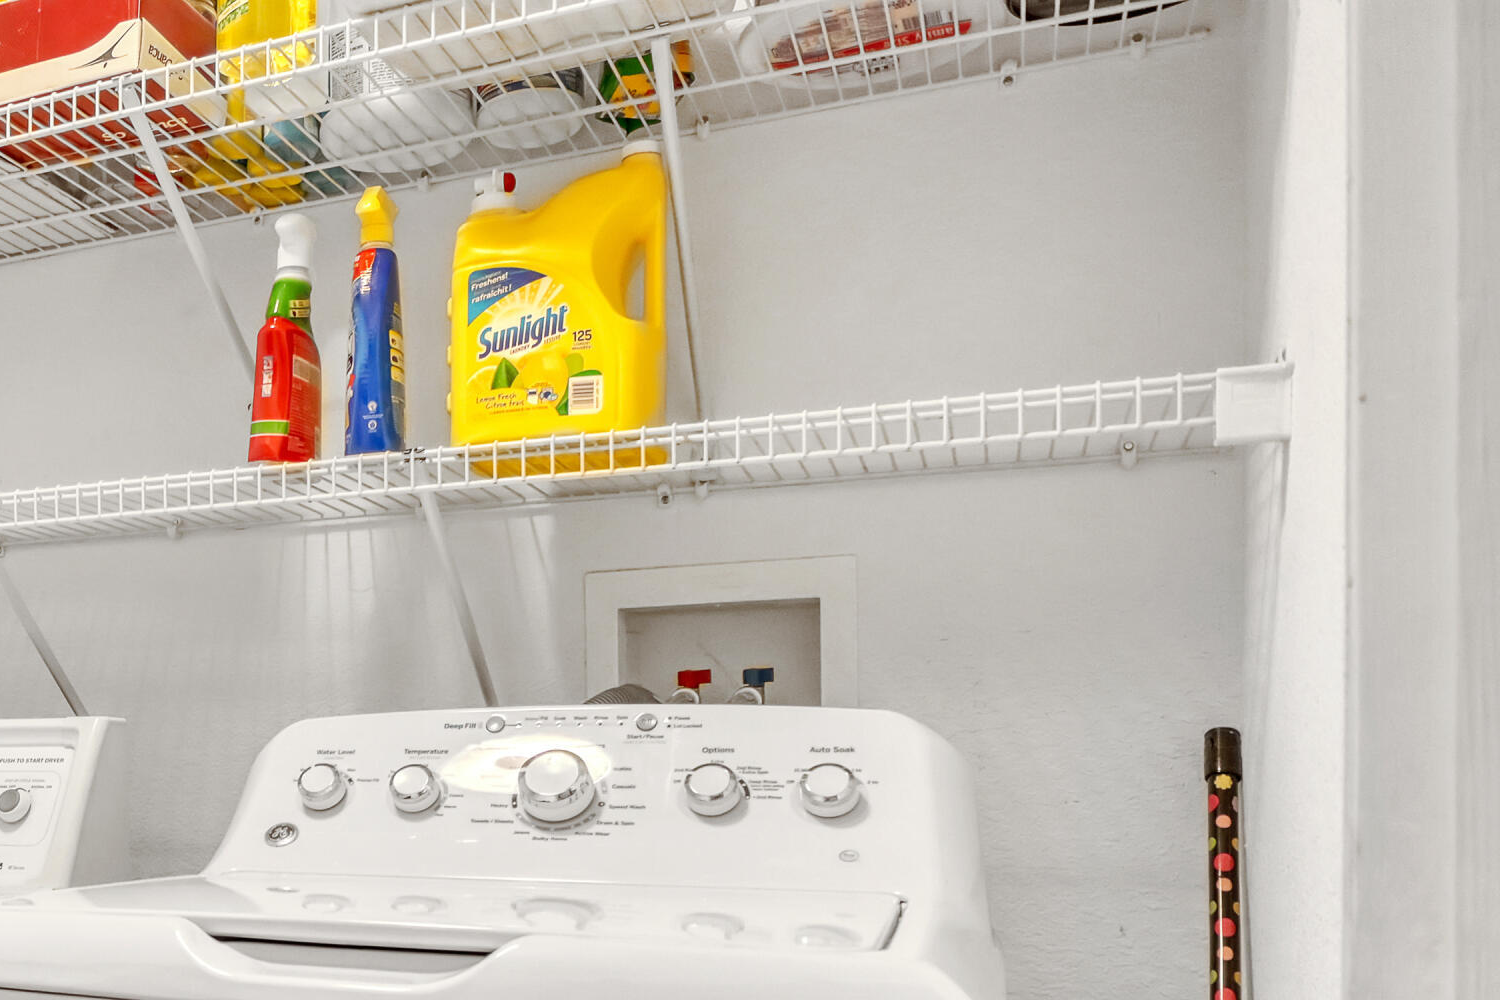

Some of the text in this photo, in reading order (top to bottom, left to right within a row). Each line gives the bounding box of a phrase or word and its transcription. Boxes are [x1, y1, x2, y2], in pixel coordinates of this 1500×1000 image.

[478, 304, 569, 360] Sunlight
[572, 329, 592, 342] 125
[444, 722, 461, 731] Deep
[404, 748, 449, 757] Temperature
[701, 747, 735, 755] Options
[809, 746, 856, 754] Auto Soak
